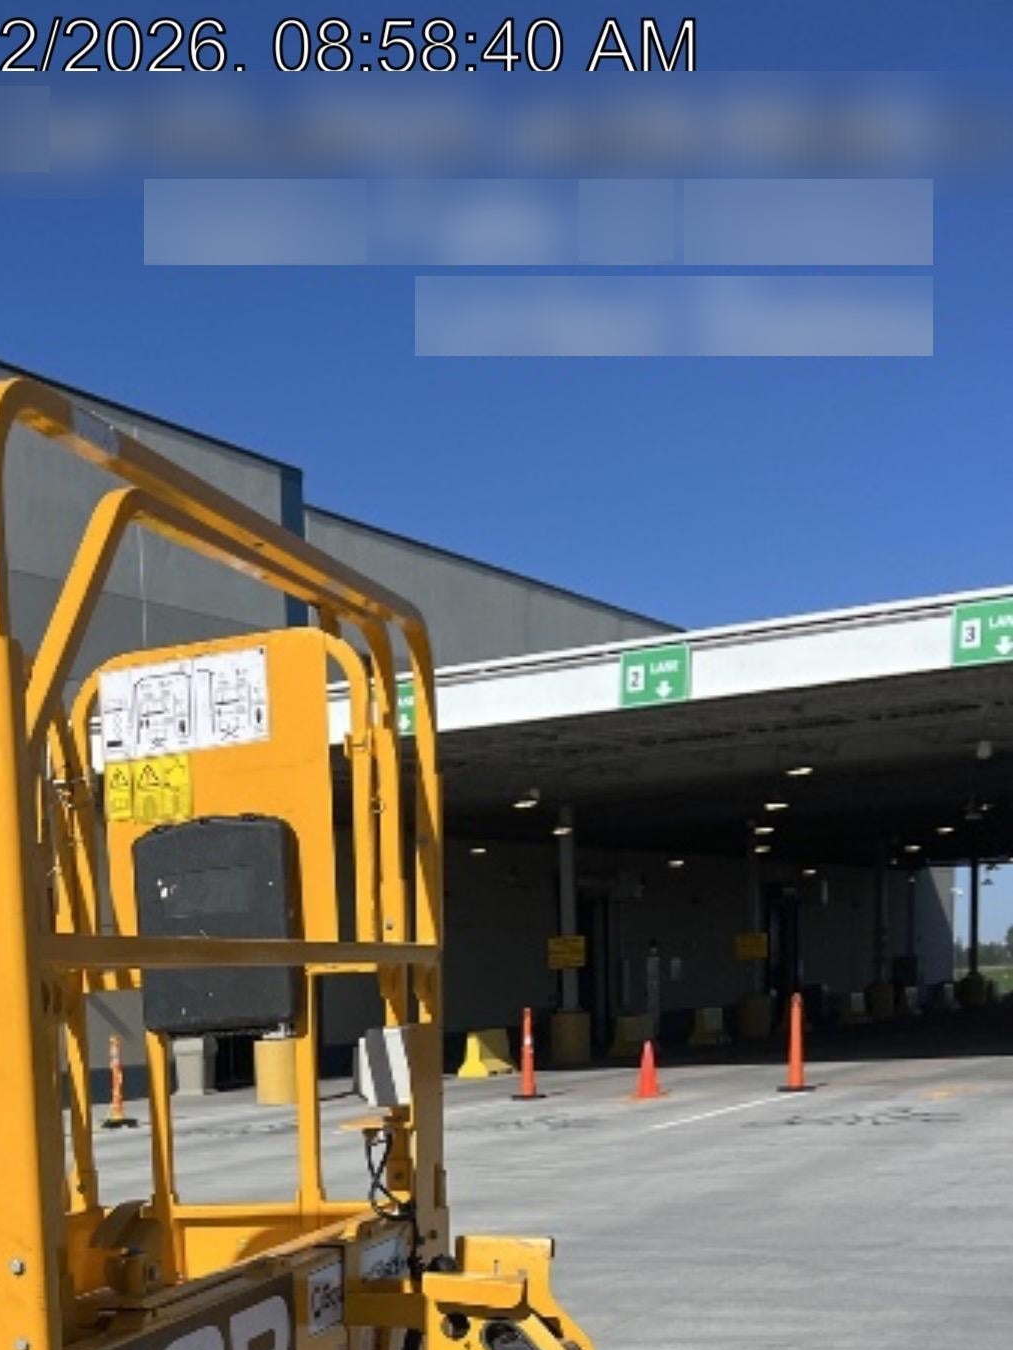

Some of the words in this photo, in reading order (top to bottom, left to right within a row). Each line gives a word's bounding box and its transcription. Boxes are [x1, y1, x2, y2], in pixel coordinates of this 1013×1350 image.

[964, 625, 976, 643] 3
[631, 671, 640, 688] 2
[649, 659, 678, 675] LANE
